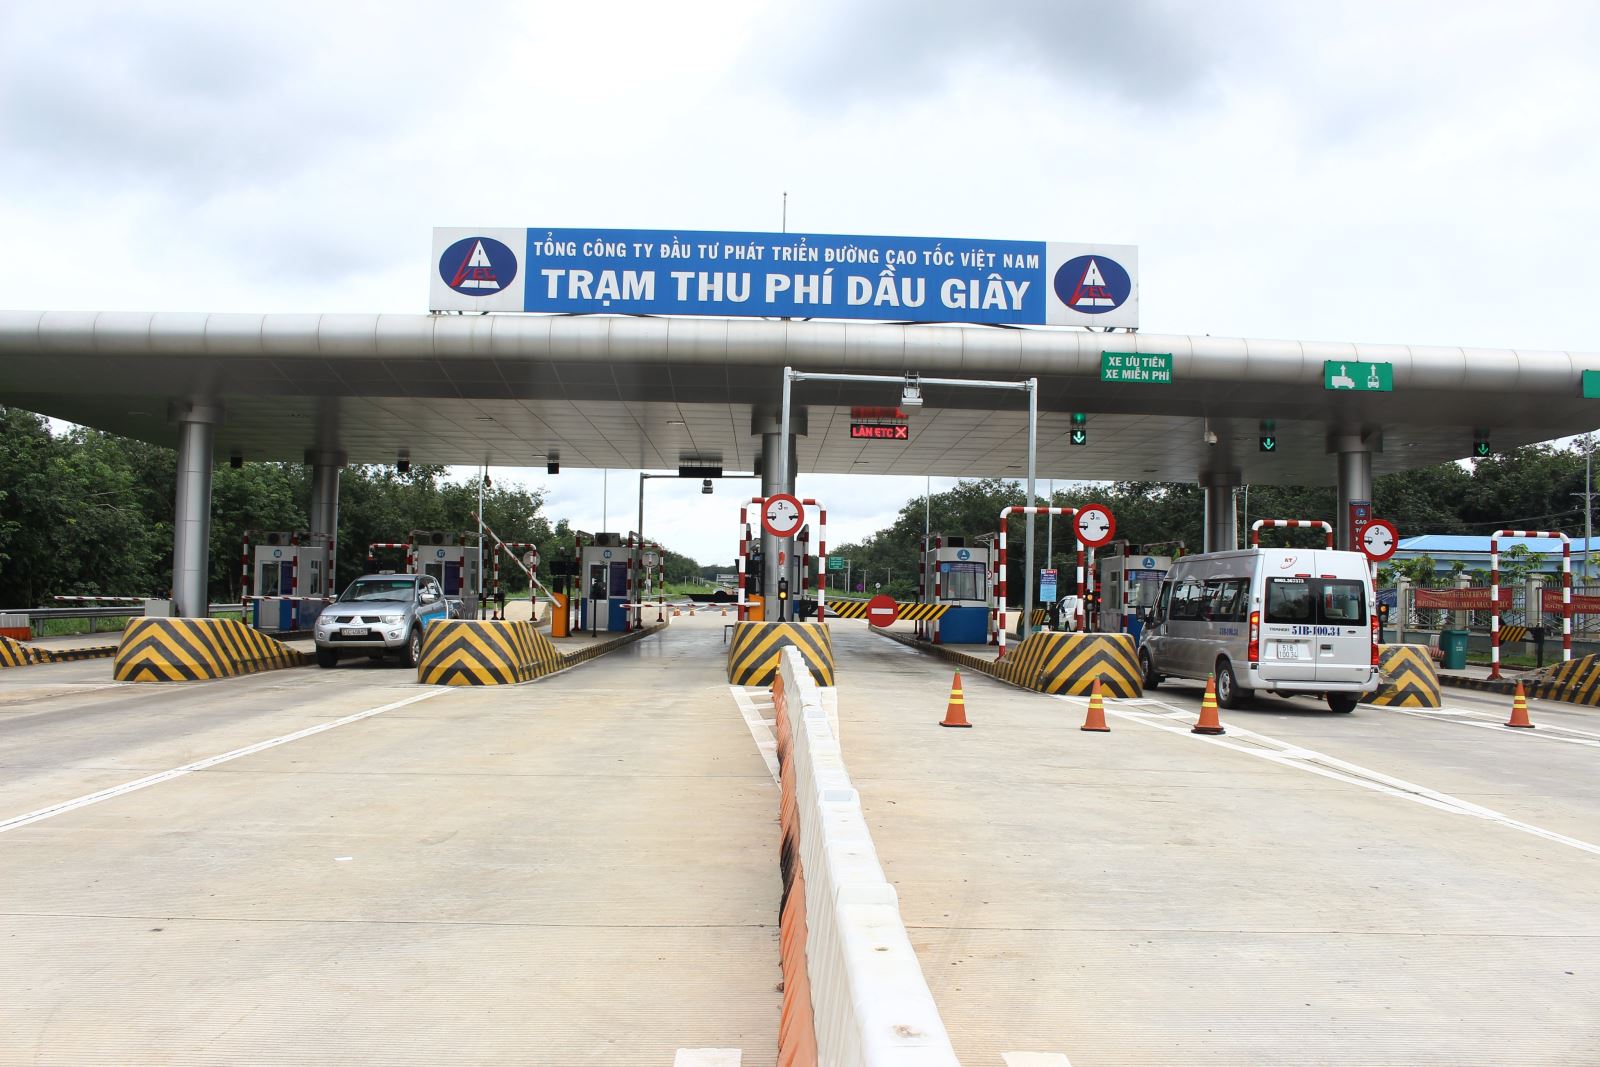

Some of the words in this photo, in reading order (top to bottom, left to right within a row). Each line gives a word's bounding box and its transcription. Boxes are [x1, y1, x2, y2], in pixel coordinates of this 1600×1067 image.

[534, 232, 576, 257] TỔNG
[583, 238, 626, 258] CÔNG
[633, 243, 653, 258] TY
[660, 236, 691, 259] ĐẦU
[698, 242, 719, 259] TƯ
[725, 242, 764, 260] PHÁT
[825, 244, 878, 264] ĐƯỜNG
[884, 250, 916, 266] CAO
[923, 244, 954, 267] TỐC
[1004, 254, 1039, 269] NAM
[542, 269, 655, 307] TRẠM
[671, 272, 751, 303] THU
[766, 268, 833, 305] PHÍ
[848, 263, 926, 308] DẦU
[941, 273, 1030, 311] GIÂY
[1108, 356, 1122, 366] XE
[1142, 356, 1165, 368] TIÊN
[1105, 369, 1119, 379] XE
[1152, 369, 1170, 381] PHÍ
[874, 427, 894, 438] ETC
[777, 502, 783, 511] 3
[1090, 511, 1095, 520] 3
[1374, 527, 1379, 535] 3
